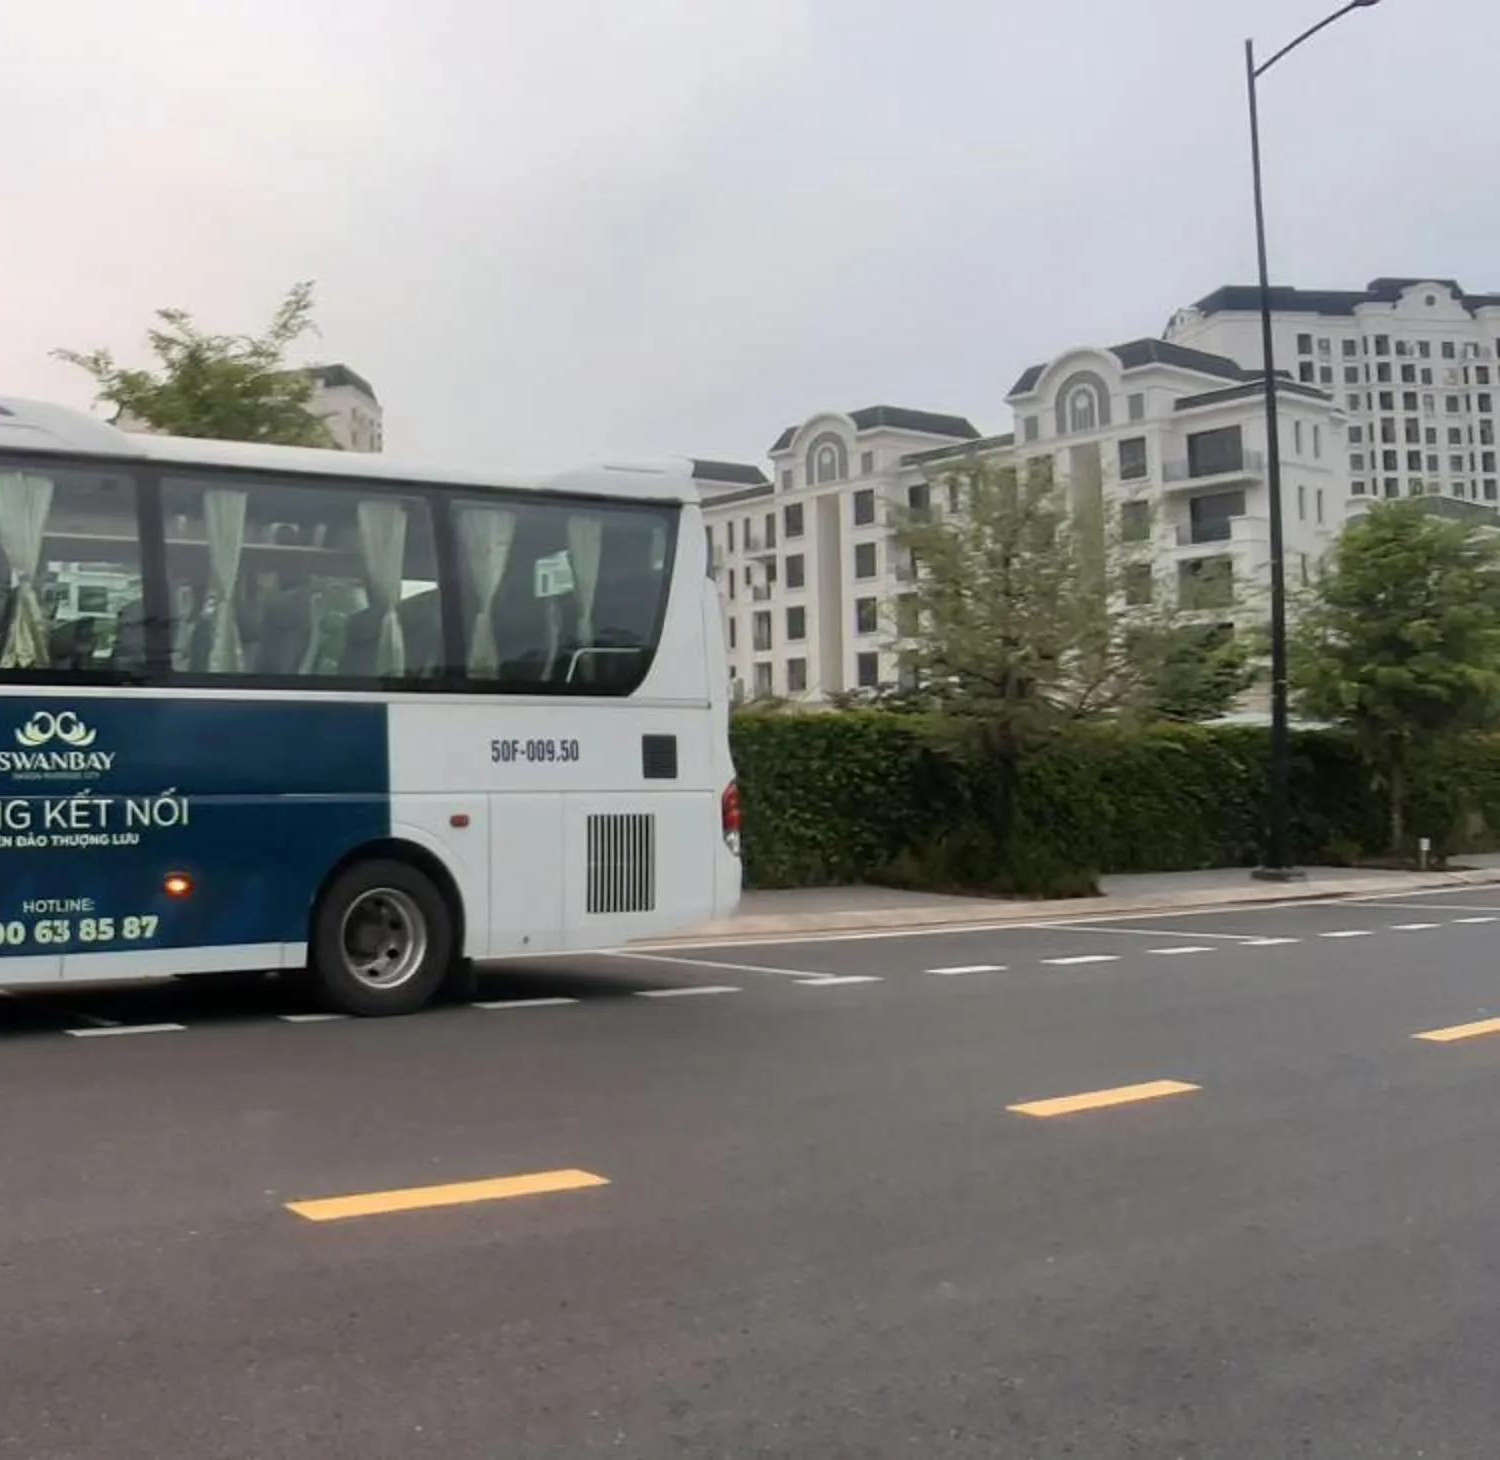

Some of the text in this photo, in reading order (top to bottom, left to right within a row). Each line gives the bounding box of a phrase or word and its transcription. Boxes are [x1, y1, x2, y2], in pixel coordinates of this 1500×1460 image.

[491, 739, 579, 762] 50F-009.50
[44, 788, 113, 829] KẾT
[126, 787, 188, 826] NỐI
[16, 831, 47, 847] ĐẢO
[51, 833, 110, 849] THƯỢNG
[112, 832, 140, 845] LƯU
[23, 898, 95, 913] HOTLINE:
[34, 919, 71, 943] 63
[79, 918, 115, 941] 85
[122, 915, 159, 938] 87
